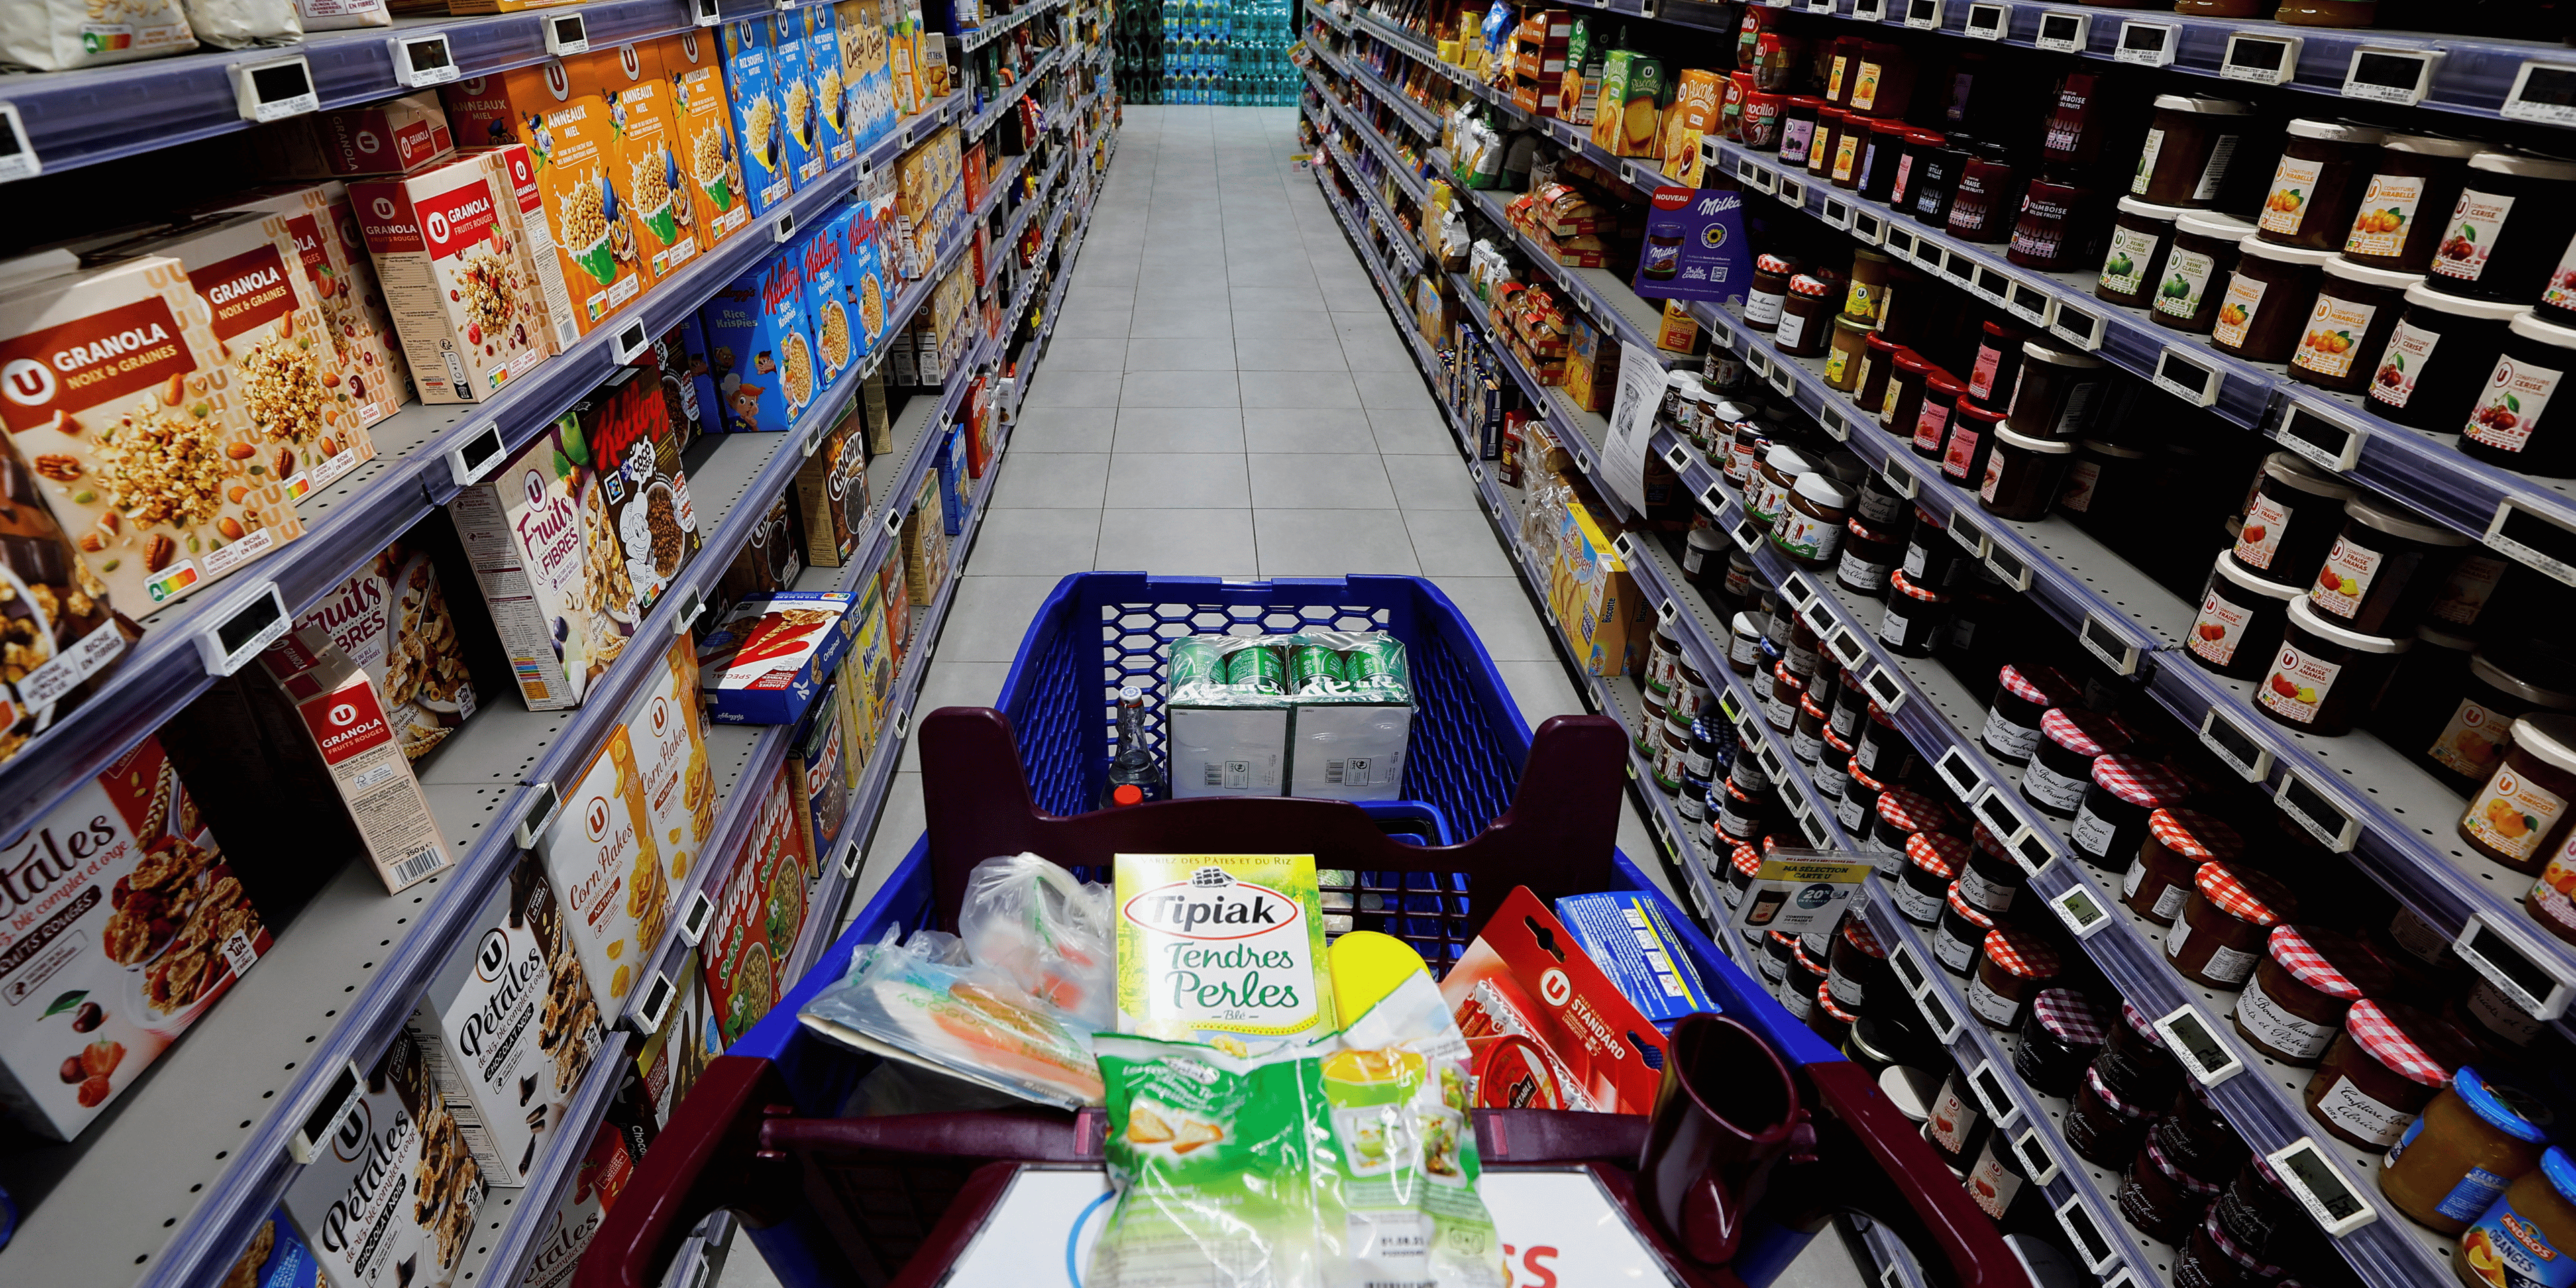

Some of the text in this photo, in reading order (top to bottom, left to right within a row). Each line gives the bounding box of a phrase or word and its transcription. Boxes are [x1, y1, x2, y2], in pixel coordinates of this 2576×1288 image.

[739, 58, 749, 68] RIZ
[748, 66, 761, 76] NATURE
[685, 67, 710, 85] ANNEAUX
[622, 85, 654, 105] ANNEAUX
[696, 83, 706, 93] MIEL
[547, 105, 587, 129] ANNEAUX
[635, 103, 649, 114] MIEL
[1746, 104, 1774, 116] nocilla
[409, 129, 430, 146] GRANOLA
[564, 125, 580, 139] MIEL
[2286, 172, 2314, 182] MIRABELLE
[516, 182, 537, 197] GRANOLA
[1655, 194, 1688, 202] NOUVEAU
[447, 197, 491, 223] GRANOLA
[1698, 195, 1743, 216] Milka
[2029, 201, 2068, 215] FRAMBOISE
[2471, 209, 2496, 219] CERISE
[366, 224, 418, 235] GRANOLA
[453, 213, 494, 236] FRUITS ROUGES
[2126, 244, 2146, 254] CLAUDE
[2128, 235, 2151, 245] CONFITURE
[2130, 240, 2145, 248] REINE
[1650, 247, 1678, 258] Milka
[2184, 256, 2208, 266] CONFITURE
[2182, 264, 2203, 275] CLAUDE
[2186, 261, 2202, 269] REINE
[209, 267, 281, 305] GRANOLA
[219, 286, 286, 321] NOIX GRAINES
[2331, 313, 2366, 326] MIRABELLE
[2334, 308, 2366, 321] CONFITURE
[1669, 324, 1694, 335] Biscottes
[52, 323, 170, 372] GRANOLA
[2402, 333, 2430, 348] CONFITURE
[2402, 340, 2424, 353] CERISE
[66, 343, 178, 390] NOIX GRAINES
[2514, 379, 2542, 391] CERISE
[2515, 371, 2551, 387] CONFITURE
[2260, 506, 2284, 519] CONFITURE
[2261, 511, 2278, 523] FRAISE
[517, 496, 574, 561] Fruits
[241, 533, 262, 547] RICHE
[541, 527, 578, 576] FIBRES
[1562, 533, 1592, 578] Heudebert
[2346, 547, 2375, 562] CONFITURE
[2347, 553, 2369, 566] FRAISE
[2343, 557, 2368, 572] ANANAS
[299, 578, 382, 635] ruits
[1601, 597, 1616, 623] Biscotte
[2218, 604, 2243, 620] CONFITURE
[2219, 611, 2238, 623] FRAISE
[334, 610, 386, 653] BRES
[822, 636, 841, 662] Original
[2298, 667, 2326, 682] ANANAS
[2302, 659, 2333, 674] CONFITURE
[2303, 664, 2326, 678] FRAISE
[321, 718, 382, 749] GRANOLA
[328, 727, 385, 755] FRUITS ROUGES
[641, 724, 687, 796] Corn Flakes
[2517, 793, 2555, 818] ABRICOT
[100, 840, 130, 870] orge
[405, 847, 419, 859] 350
[1203, 855, 1235, 865] PÂTES
[1255, 857, 1271, 865] DU
[1275, 857, 1291, 865] RIZ
[570, 822, 633, 911] Corn Flakes
[584, 860, 623, 916] pétales maïs
[11, 869, 87, 928] blé complet
[530, 886, 541, 910] SOURCE
[594, 884, 616, 918] NATURE
[1147, 895, 1275, 932] Tipiak
[1164, 941, 1294, 969] Tendres
[1164, 969, 1299, 1009] Perles
[460, 947, 541, 1058] Pétales
[2253, 997, 2280, 1022] Bonne
[478, 965, 546, 1069] de blé complet orge
[1223, 1009, 1246, 1021] Blé
[1566, 1008, 1589, 1036] PUISSANCE
[1589, 1005, 1615, 1036] ALCALINES
[1570, 998, 1627, 1061] STANDARD
[486, 1007, 533, 1079] CHOCOLAT NOIR
[2339, 1085, 2384, 1123] Confiture
[322, 1110, 409, 1253] Pétales
[357, 1182, 405, 1273] CHOCOLAT NOIR
[2502, 1214, 2553, 1258] ANDROS
[2487, 1230, 2535, 1273] ORANGES
